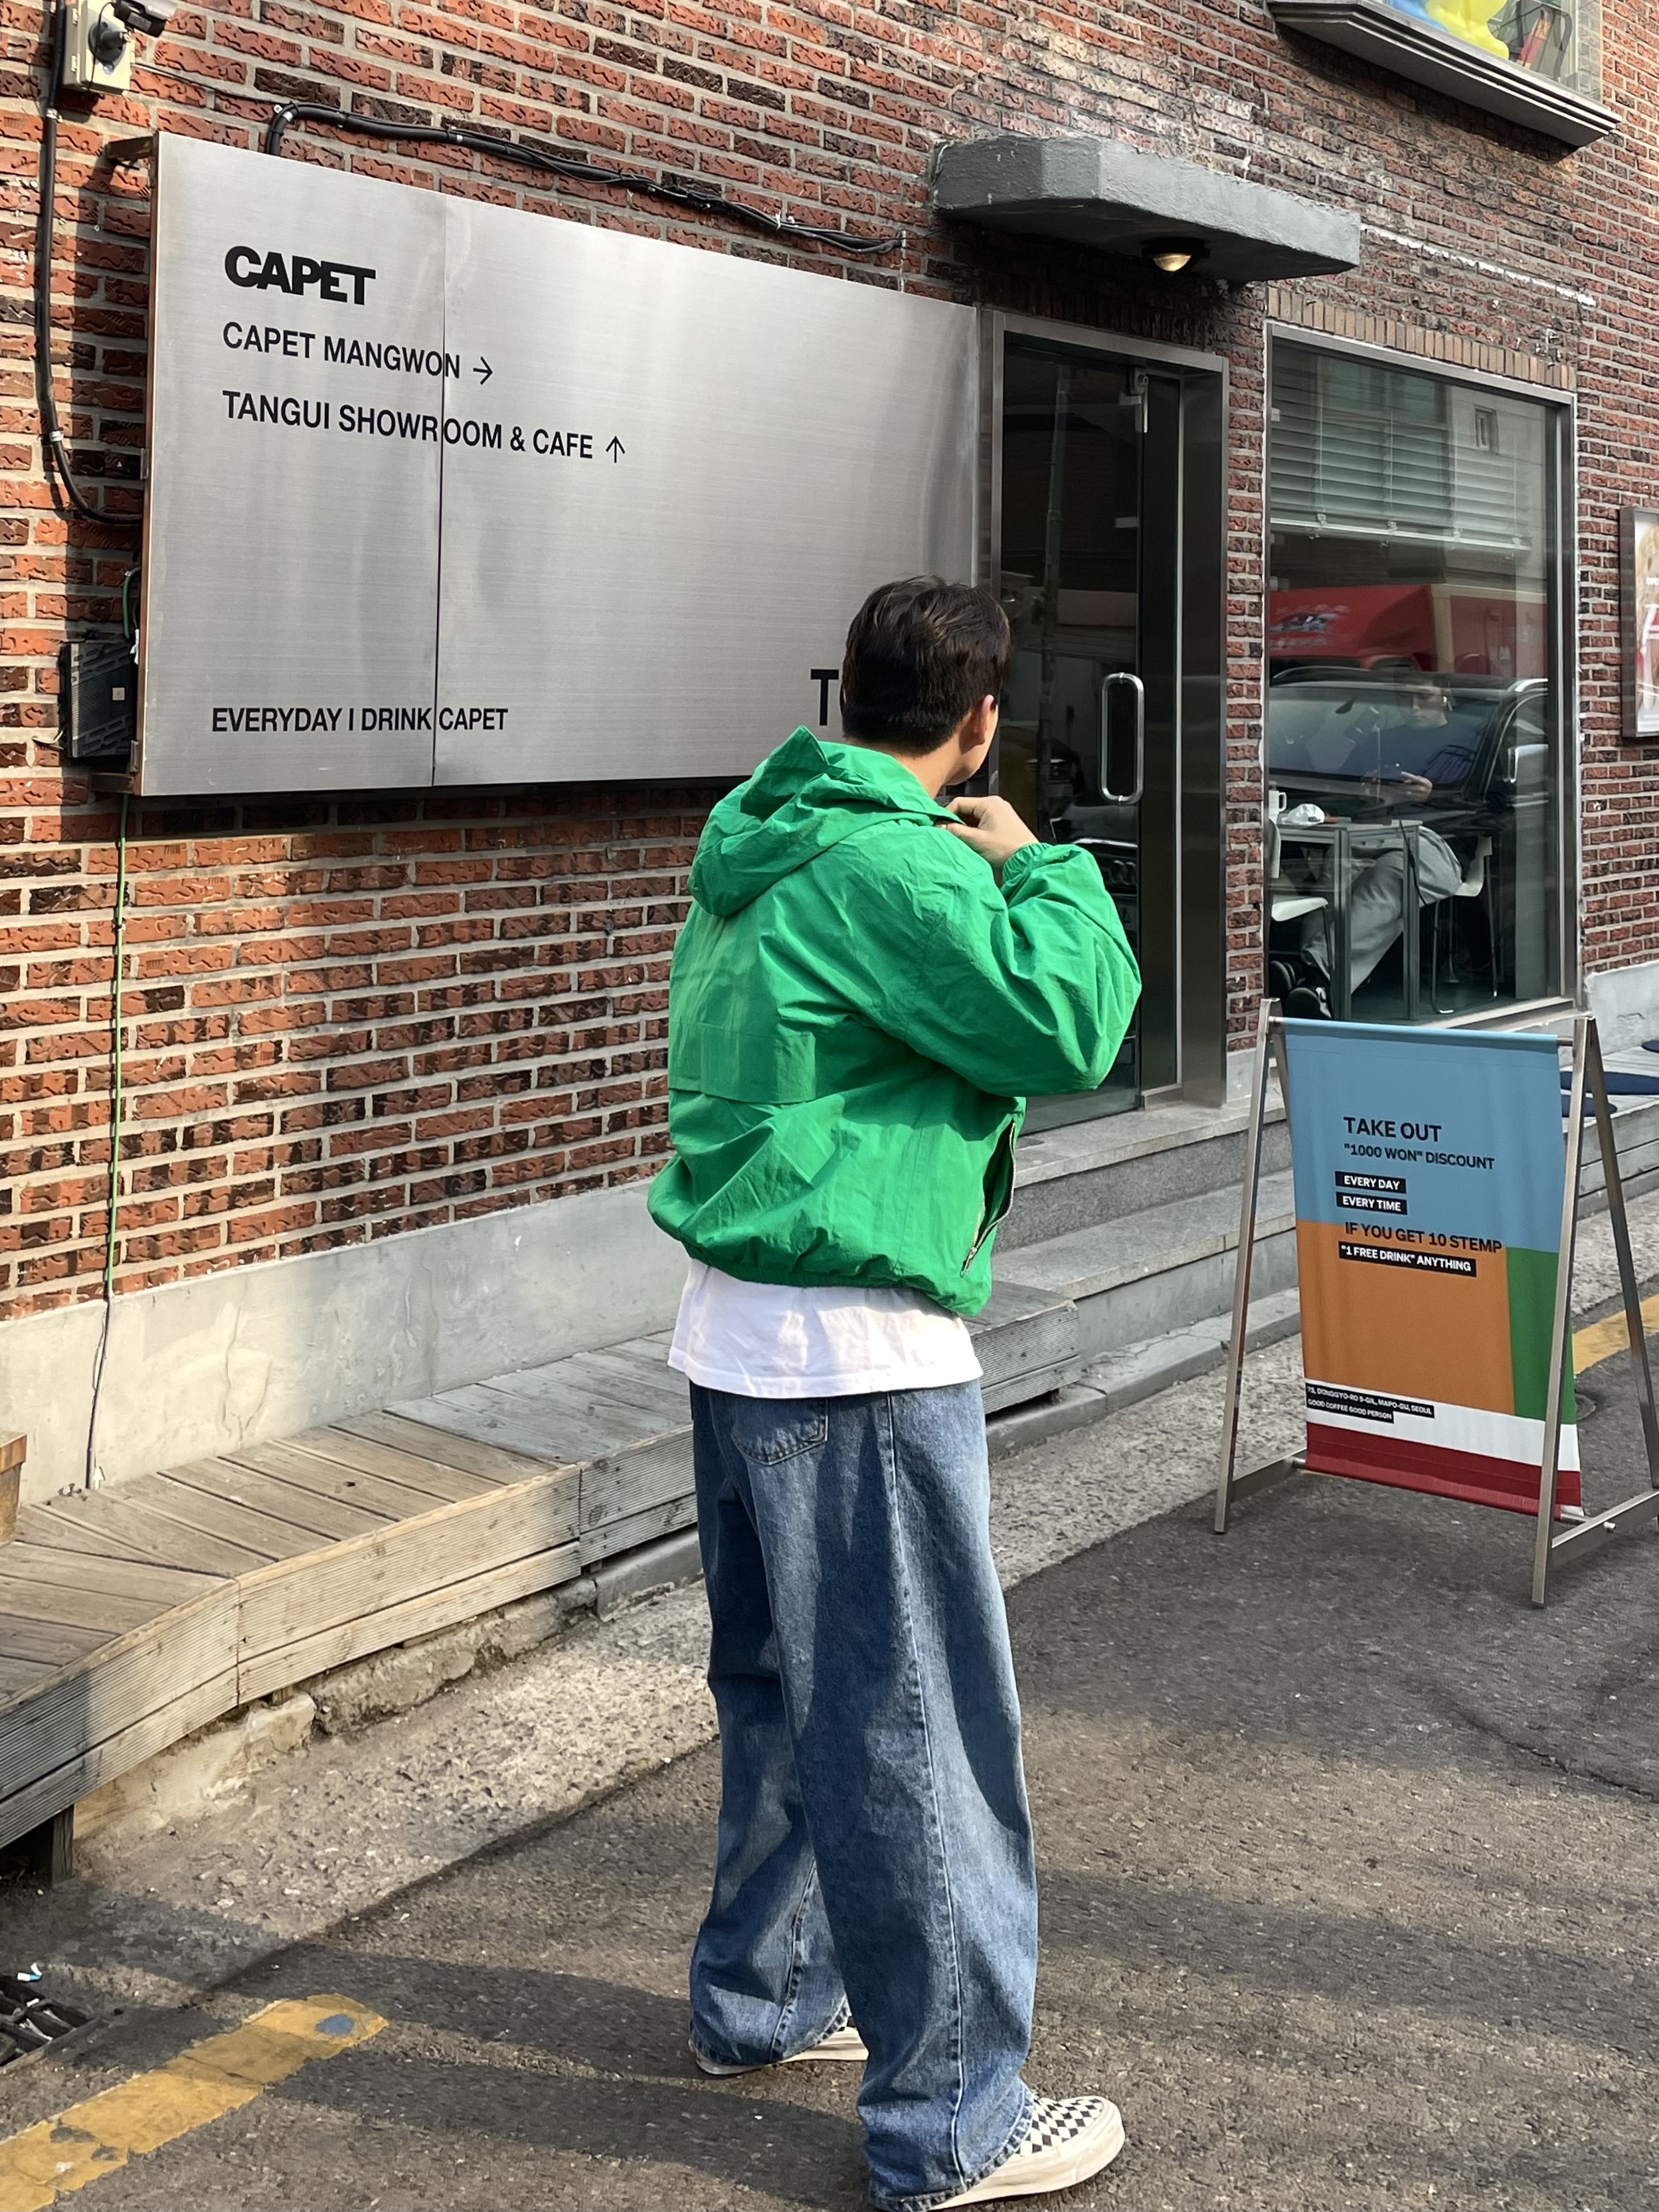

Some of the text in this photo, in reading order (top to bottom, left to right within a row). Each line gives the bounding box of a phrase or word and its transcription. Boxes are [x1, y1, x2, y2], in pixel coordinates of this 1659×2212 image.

[224, 245, 376, 305] CAPET
[222, 321, 461, 379] CAPET MANGWON
[222, 390, 593, 460] TANGUI SHOWROOM & CAFE
[212, 707, 508, 732] EVERYDAY I DRINK CAPET
[1343, 1116, 1442, 1142] TAKE OUT
[1344, 1143, 1495, 1170] "1000 WON" DISCOUNT
[1344, 1175, 1400, 1191] EVERY DAY
[1342, 1196, 1402, 1212] EVERY TIME
[1345, 1222, 1502, 1253] IF YOU GET 10 STEMP
[1341, 1245, 1472, 1272] "1 FREE DRINK" ANYTHING
[1307, 1399, 1393, 1420] GOOD COFFEE GOOD PERSON
